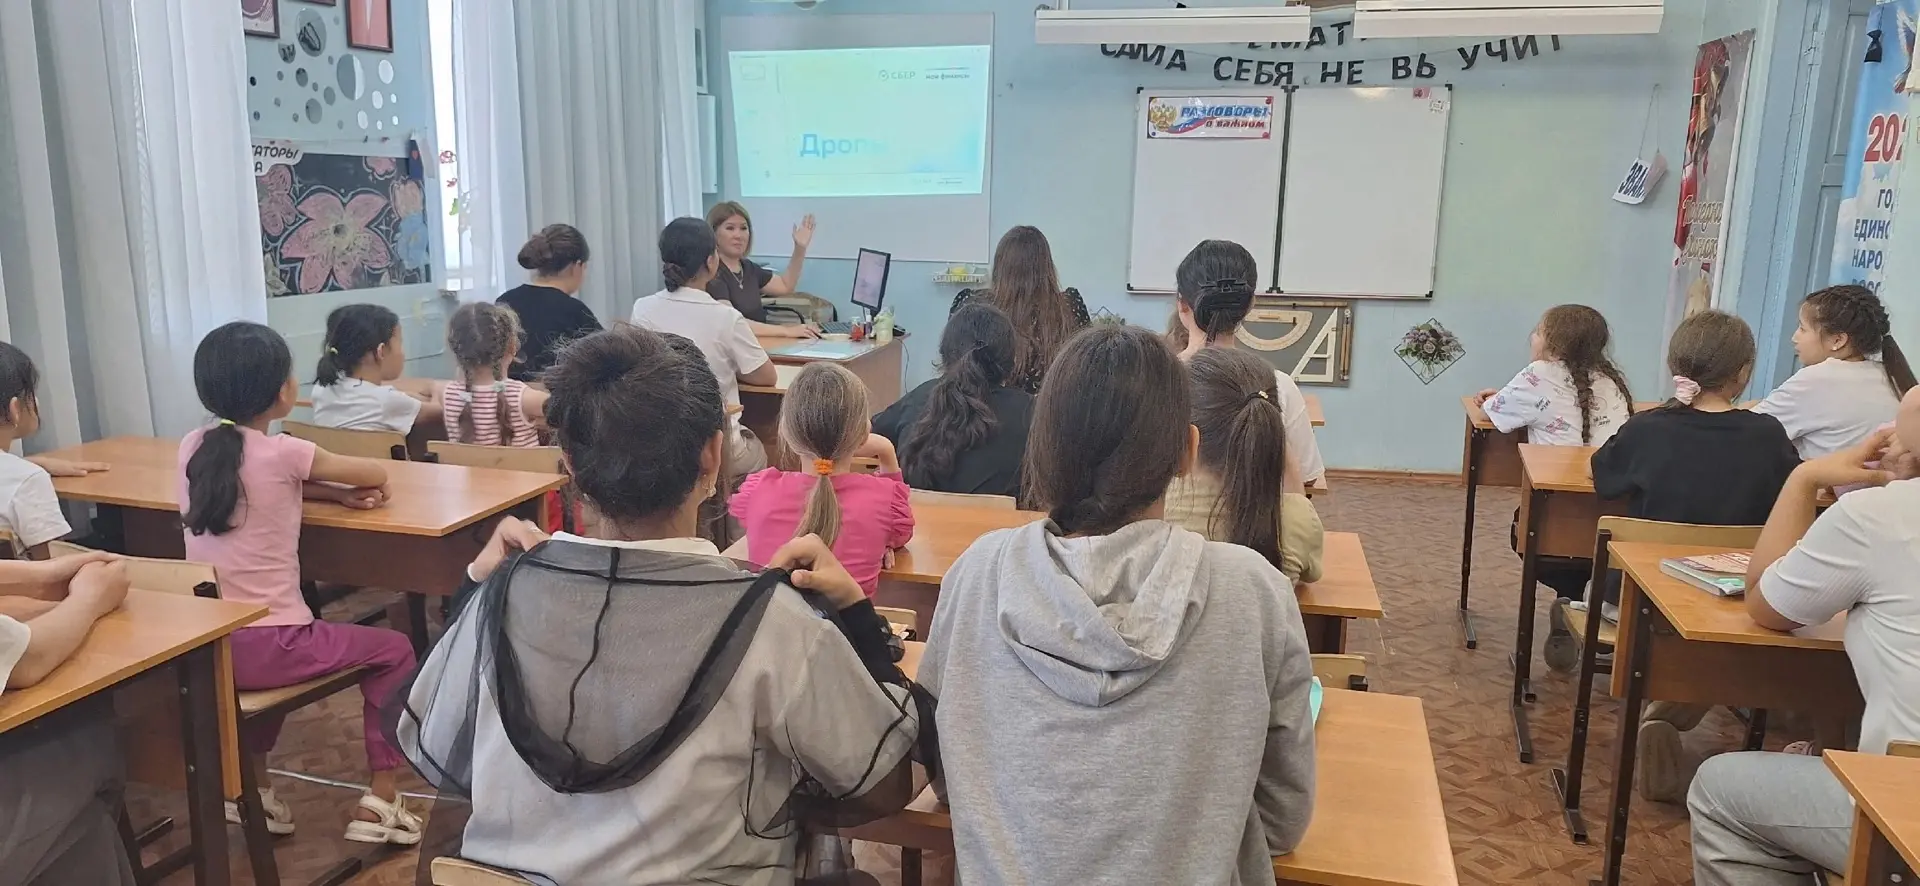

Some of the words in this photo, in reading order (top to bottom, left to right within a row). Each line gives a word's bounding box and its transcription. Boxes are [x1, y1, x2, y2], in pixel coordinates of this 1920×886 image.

[1213, 56, 1294, 87] СЕБЯ
[1320, 60, 1365, 86] НЕ
[1877, 188, 1894, 213] ГО
[1851, 248, 1884, 271] НАРО
